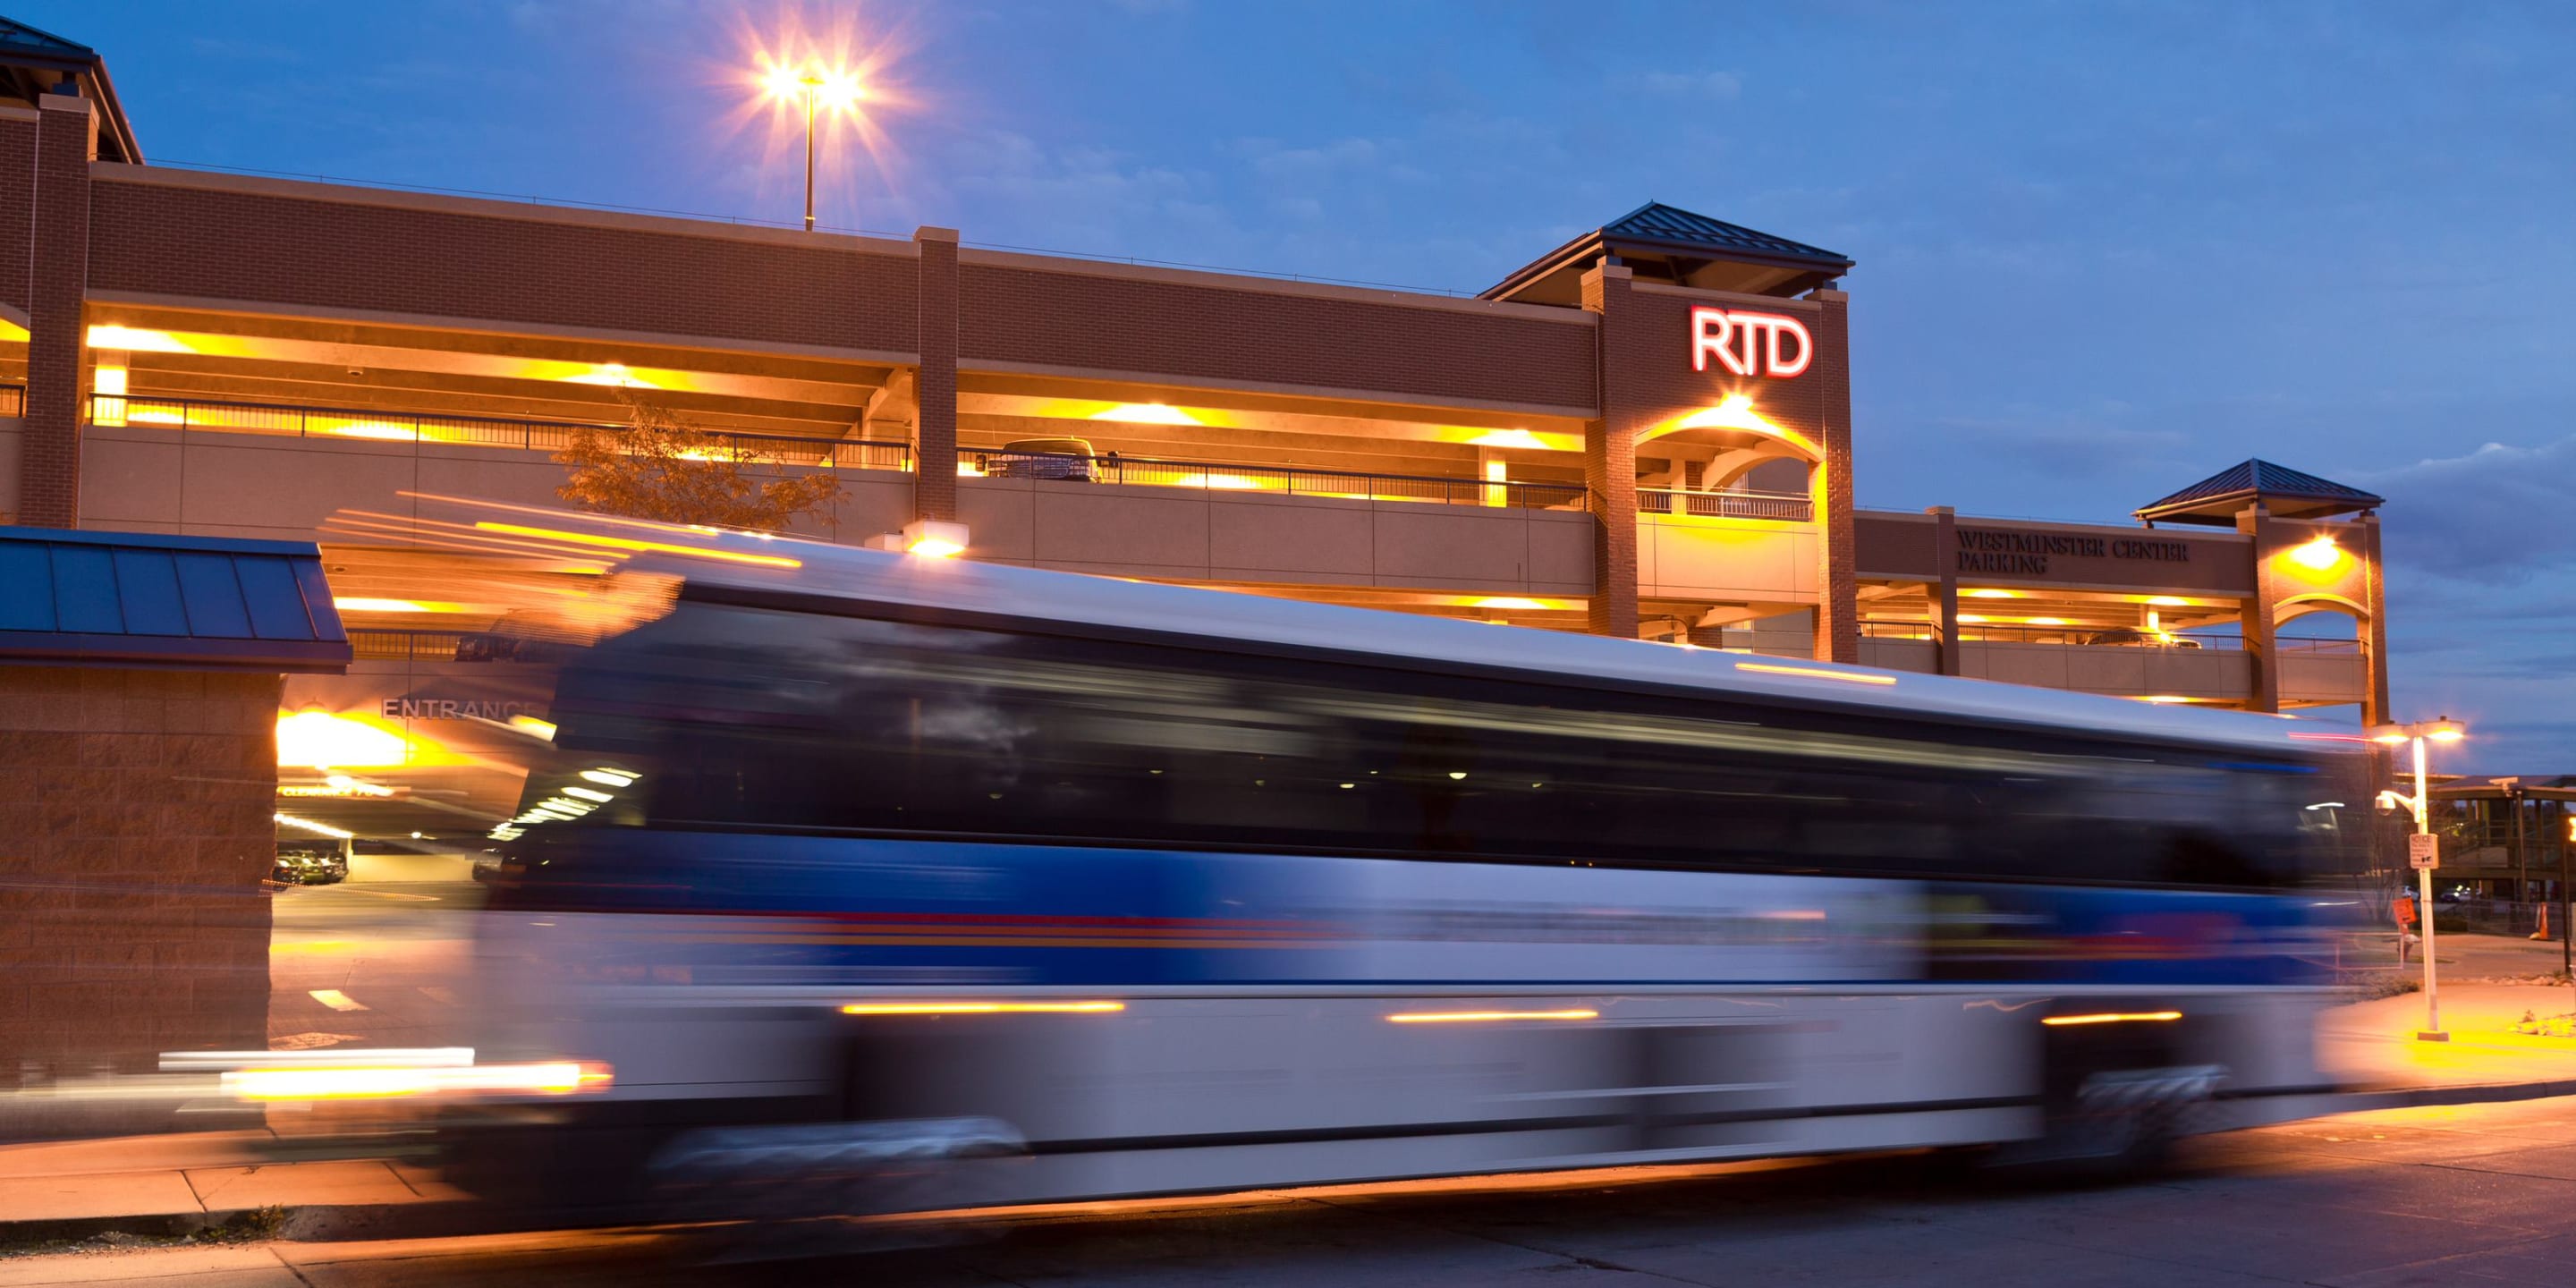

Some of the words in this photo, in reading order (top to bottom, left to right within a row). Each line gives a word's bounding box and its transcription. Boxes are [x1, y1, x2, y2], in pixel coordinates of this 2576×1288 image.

[1690, 304, 1814, 379] RTD
[1957, 530, 2106, 557] WESTMINSTER
[2113, 539, 2189, 562] CENTER
[1958, 551, 2048, 574] PARKING
[382, 699, 539, 719] ENTRANCE
